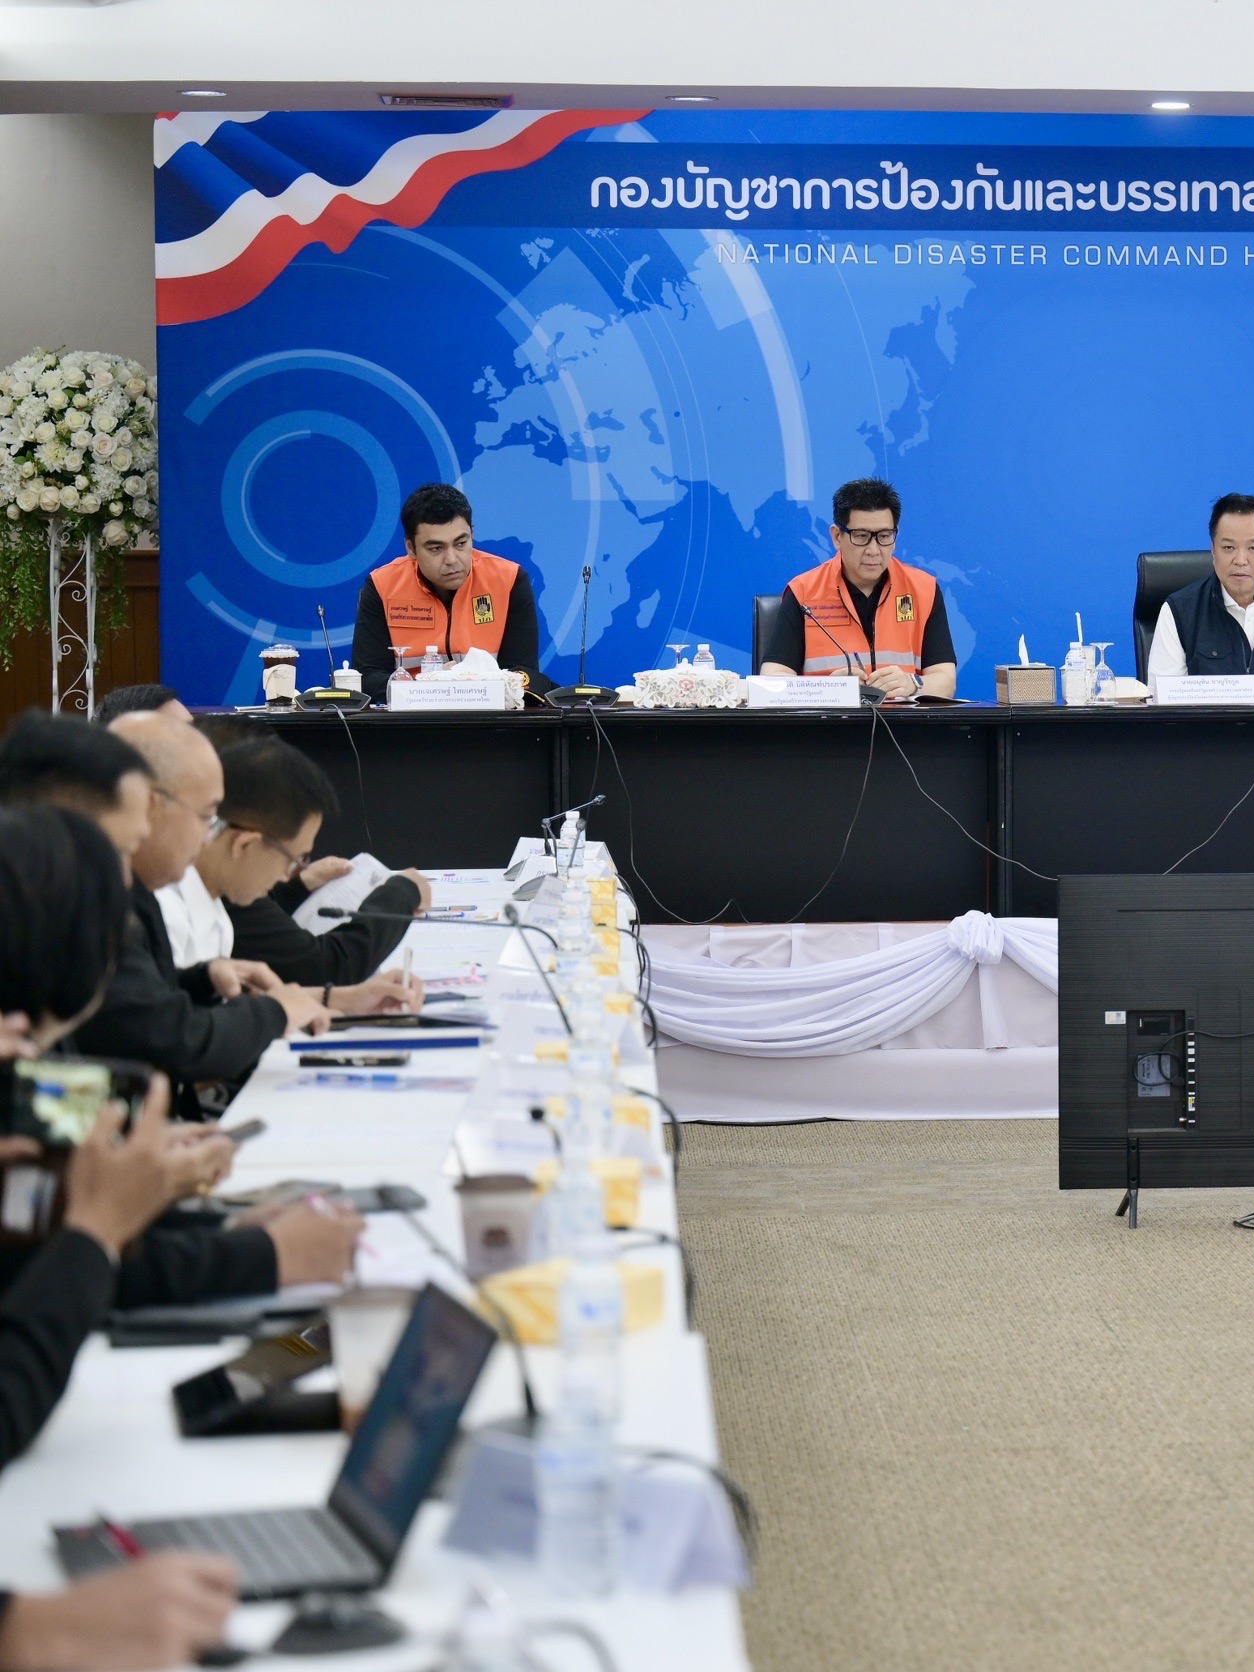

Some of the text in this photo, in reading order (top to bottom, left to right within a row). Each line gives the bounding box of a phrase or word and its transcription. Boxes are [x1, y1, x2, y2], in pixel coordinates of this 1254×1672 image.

[717, 243, 878, 265] NATIONAL
[894, 243, 1047, 266] DISASTER
[1063, 244, 1228, 267] COMMAND
